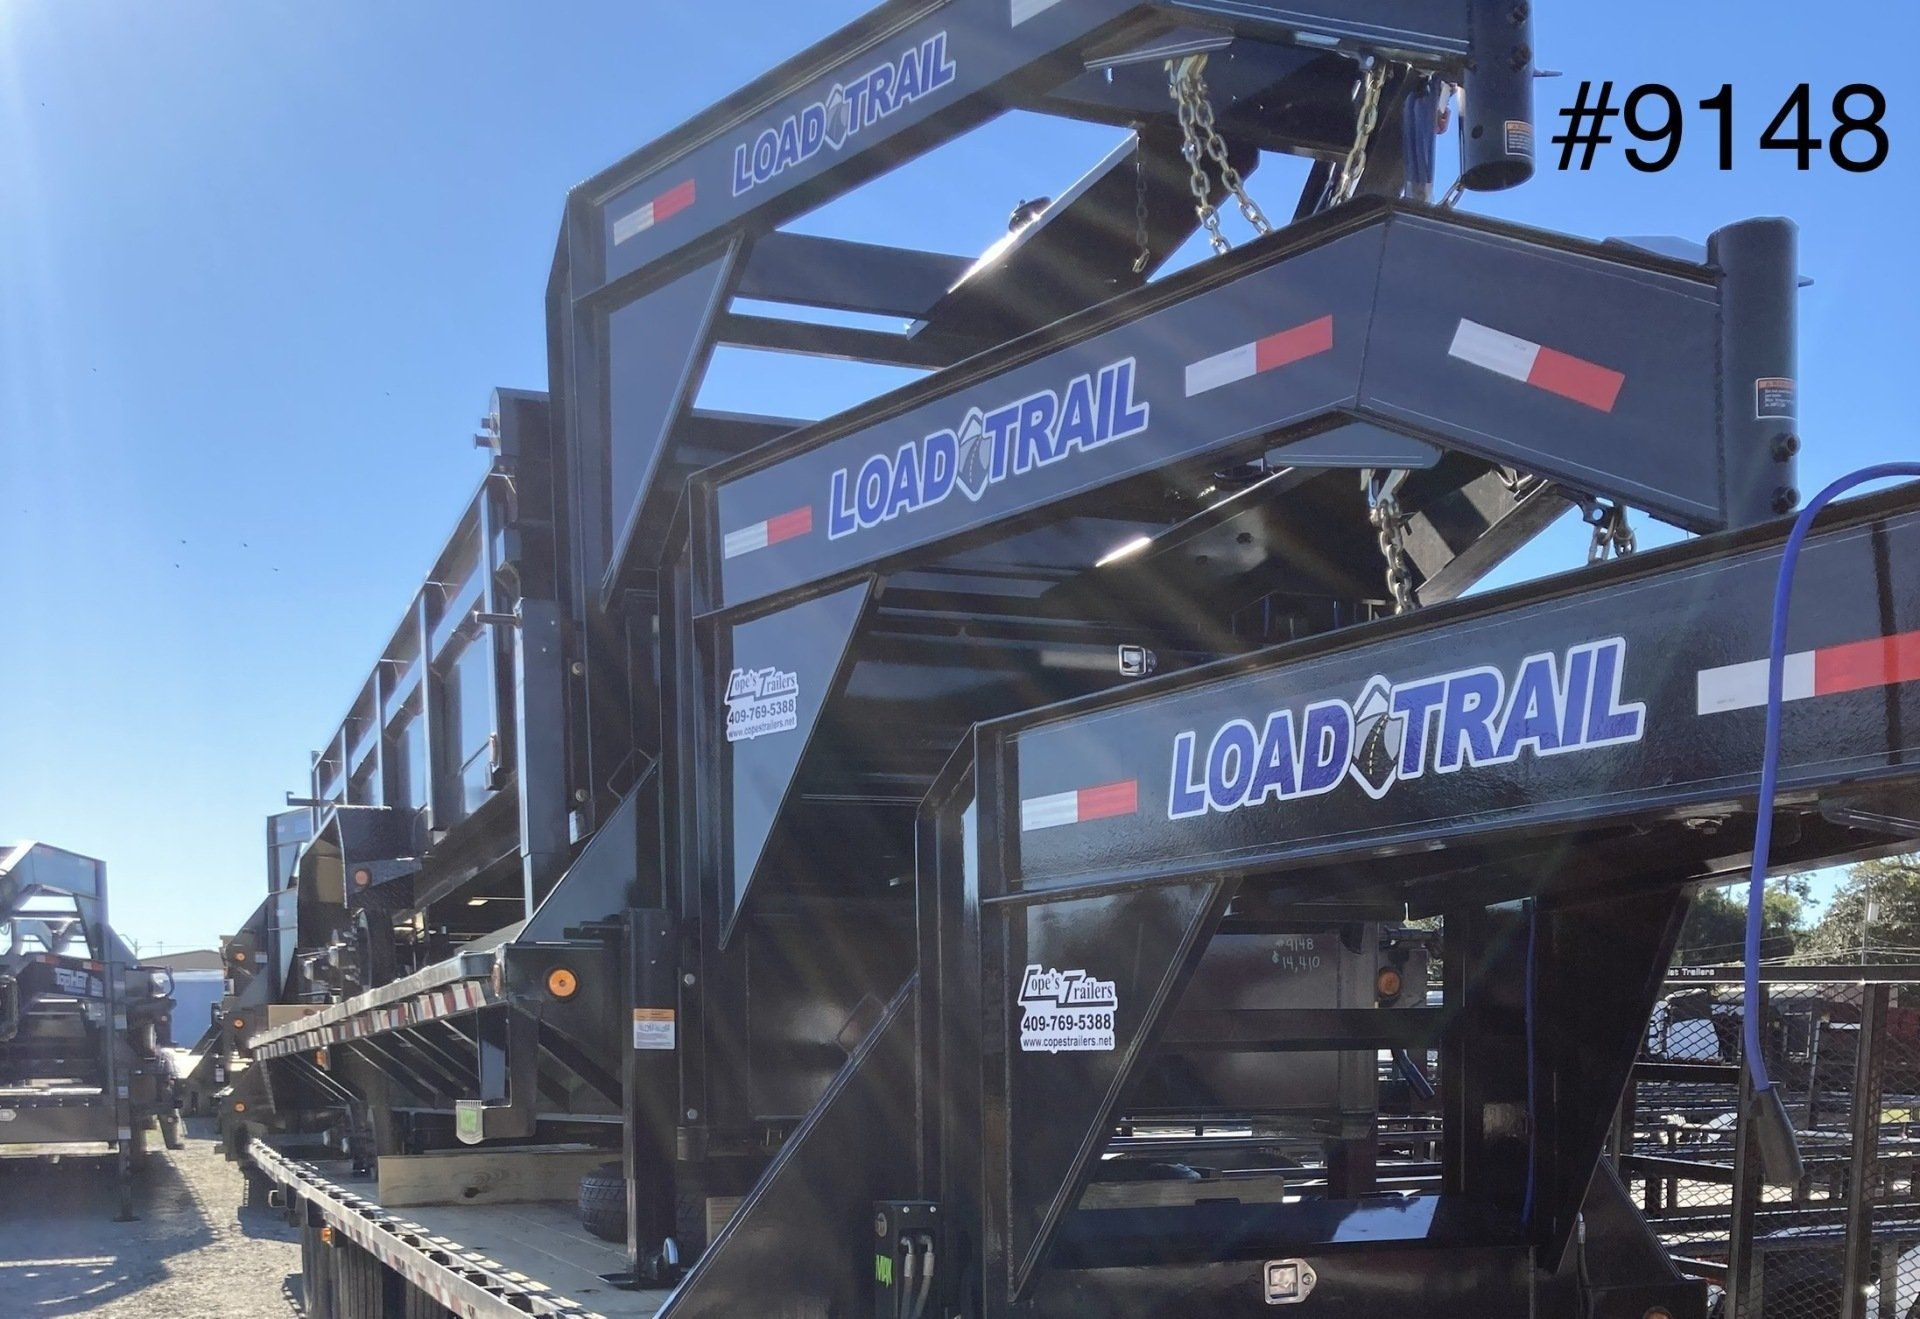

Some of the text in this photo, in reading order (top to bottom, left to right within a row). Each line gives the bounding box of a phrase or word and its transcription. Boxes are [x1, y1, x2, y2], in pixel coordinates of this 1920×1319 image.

[733, 31, 956, 197] LOAD TRAIL
[828, 356, 1149, 540] LOAD TRAIL
[727, 669, 797, 701] Cope's Trailers
[728, 699, 795, 725] 409-769-5388
[728, 716, 796, 738] www.copestrailers.net
[1168, 636, 1646, 820] LOAD TRAIL
[1021, 969, 1113, 1005] Cope's Trailers
[1023, 1013, 1111, 1031] 409-769-5388
[1023, 1036, 1112, 1049] www.copestrailers.net
